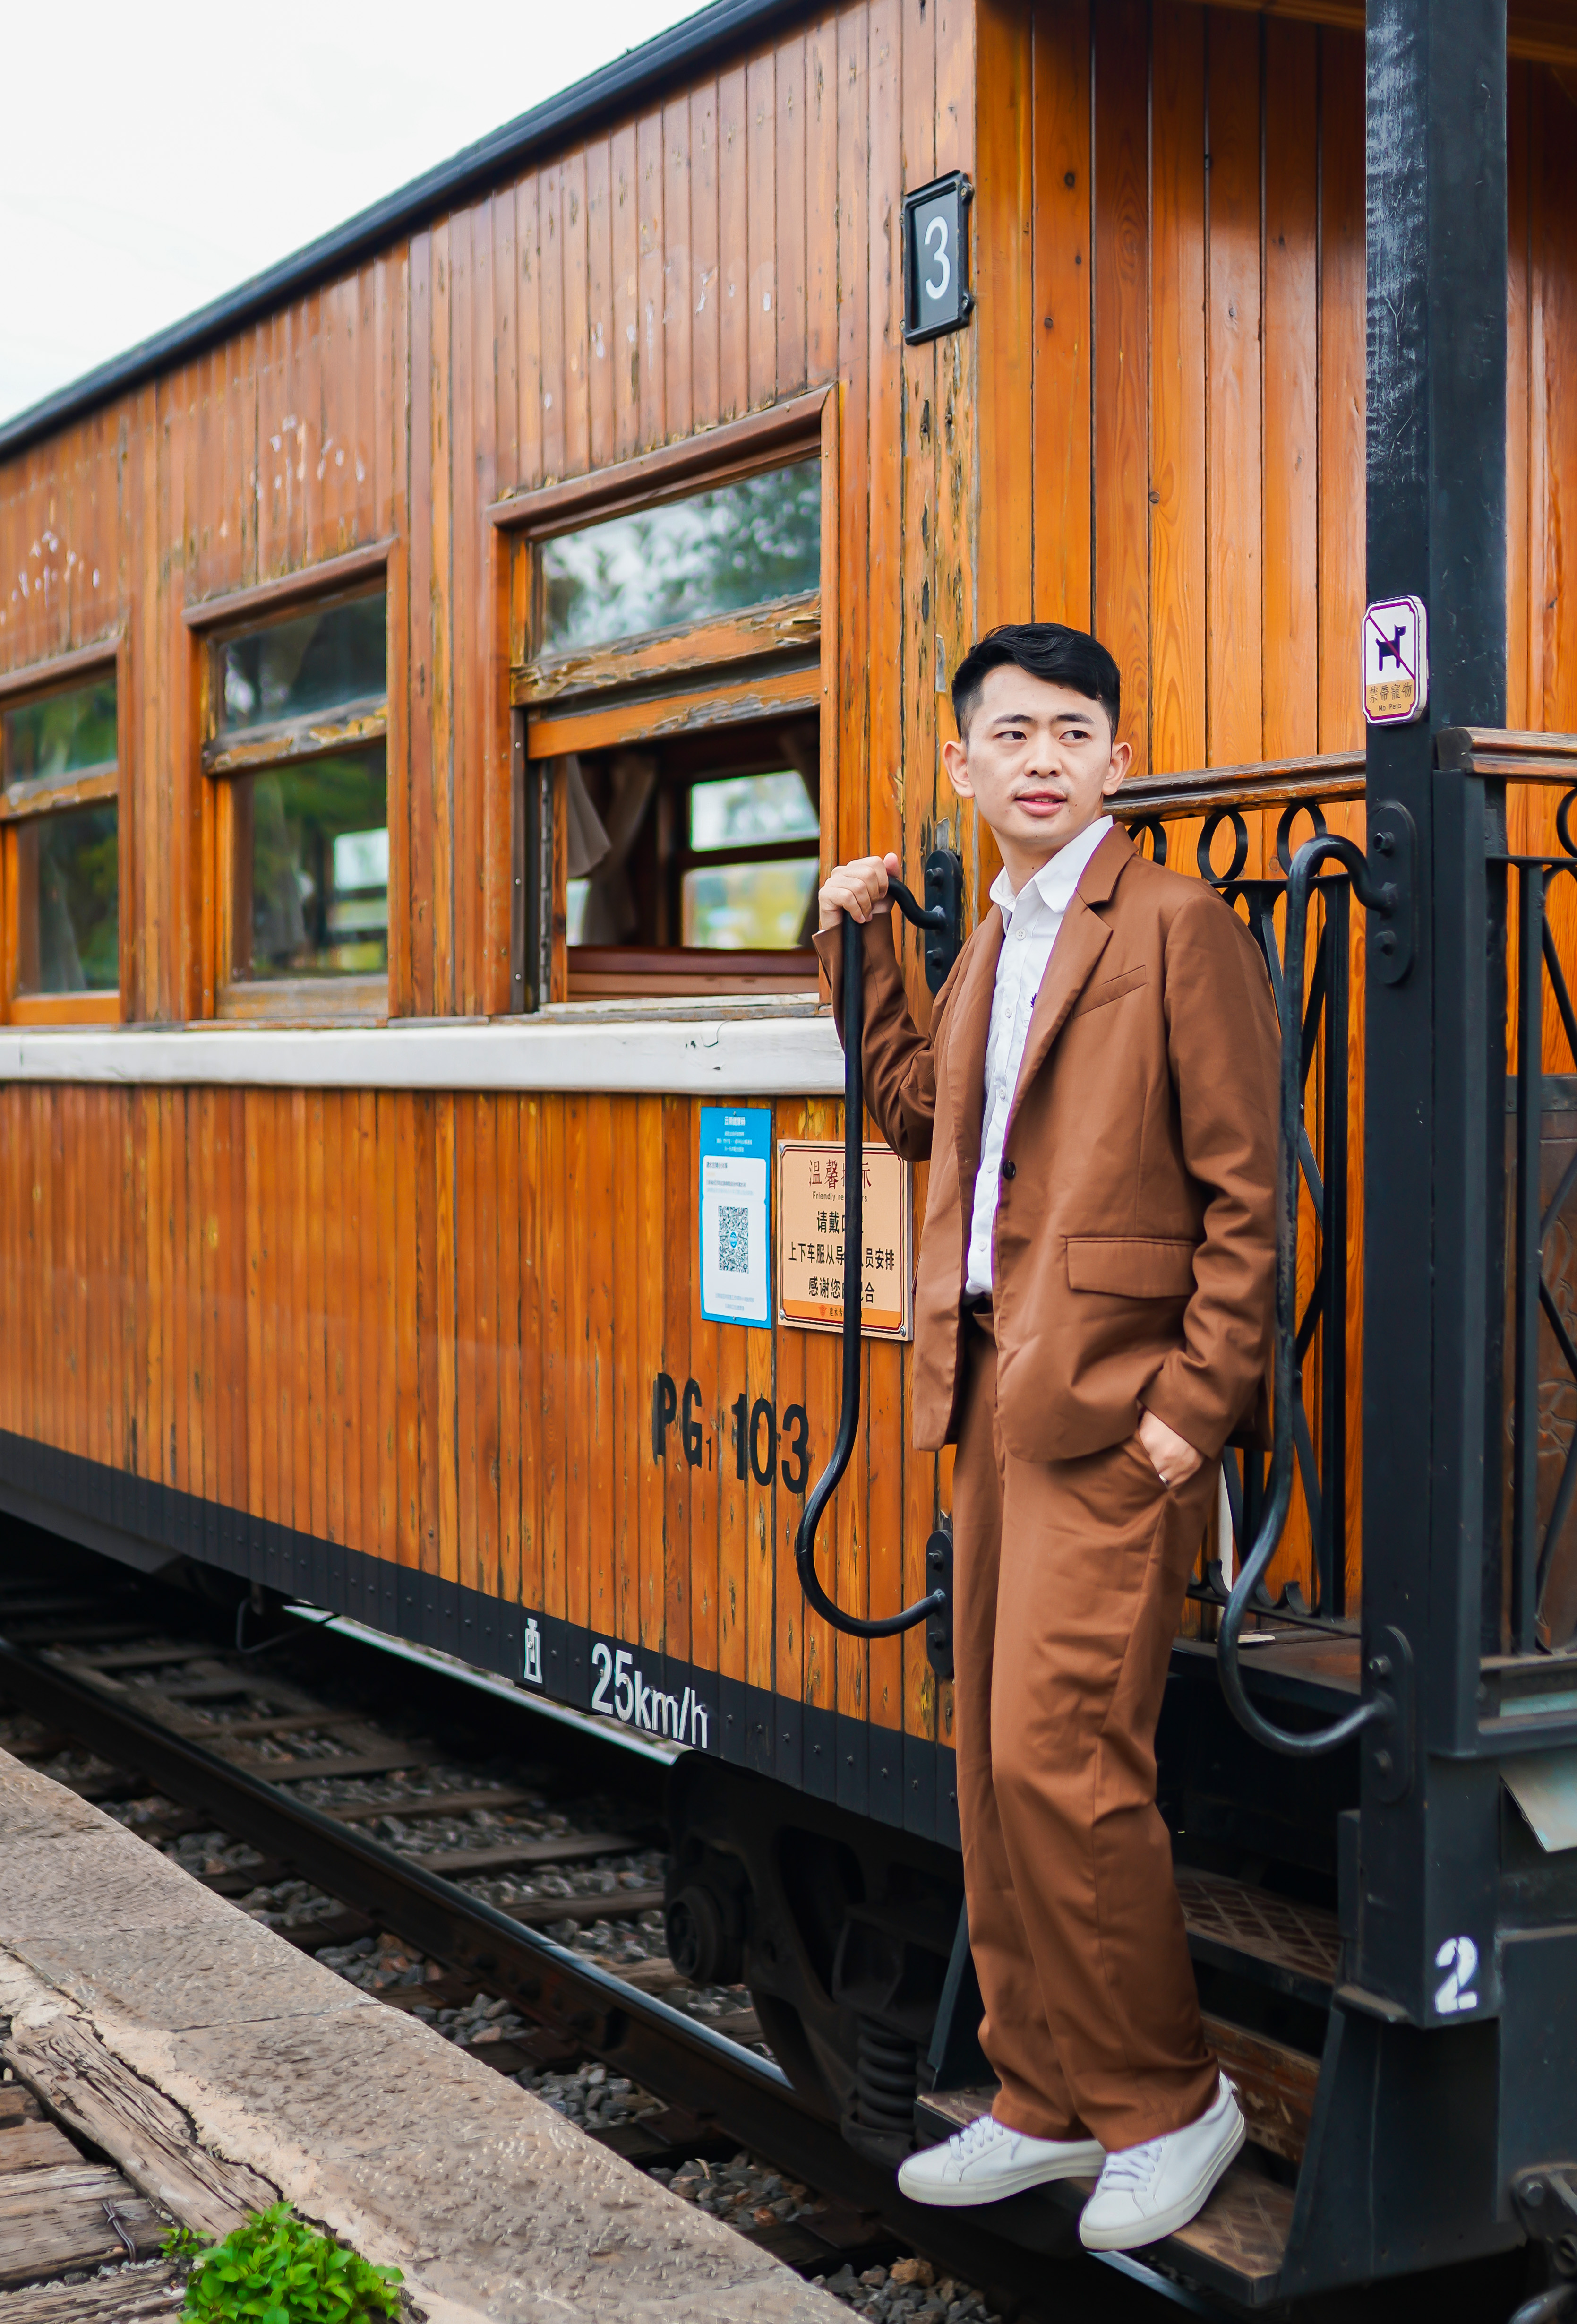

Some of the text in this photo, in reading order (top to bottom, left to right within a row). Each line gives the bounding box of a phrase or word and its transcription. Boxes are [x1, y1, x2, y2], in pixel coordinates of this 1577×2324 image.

[925, 216, 950, 299] 3
[812, 1191, 836, 1202] Friendly
[816, 1210, 864, 1234] 请戴
[788, 1241, 895, 1271] 上下车服从导员安排
[808, 1276, 875, 1303] 感谢您合
[731, 1393, 809, 1494] 103
[591, 1643, 708, 1749] 25km/h
[1434, 1936, 1478, 2014] 2
